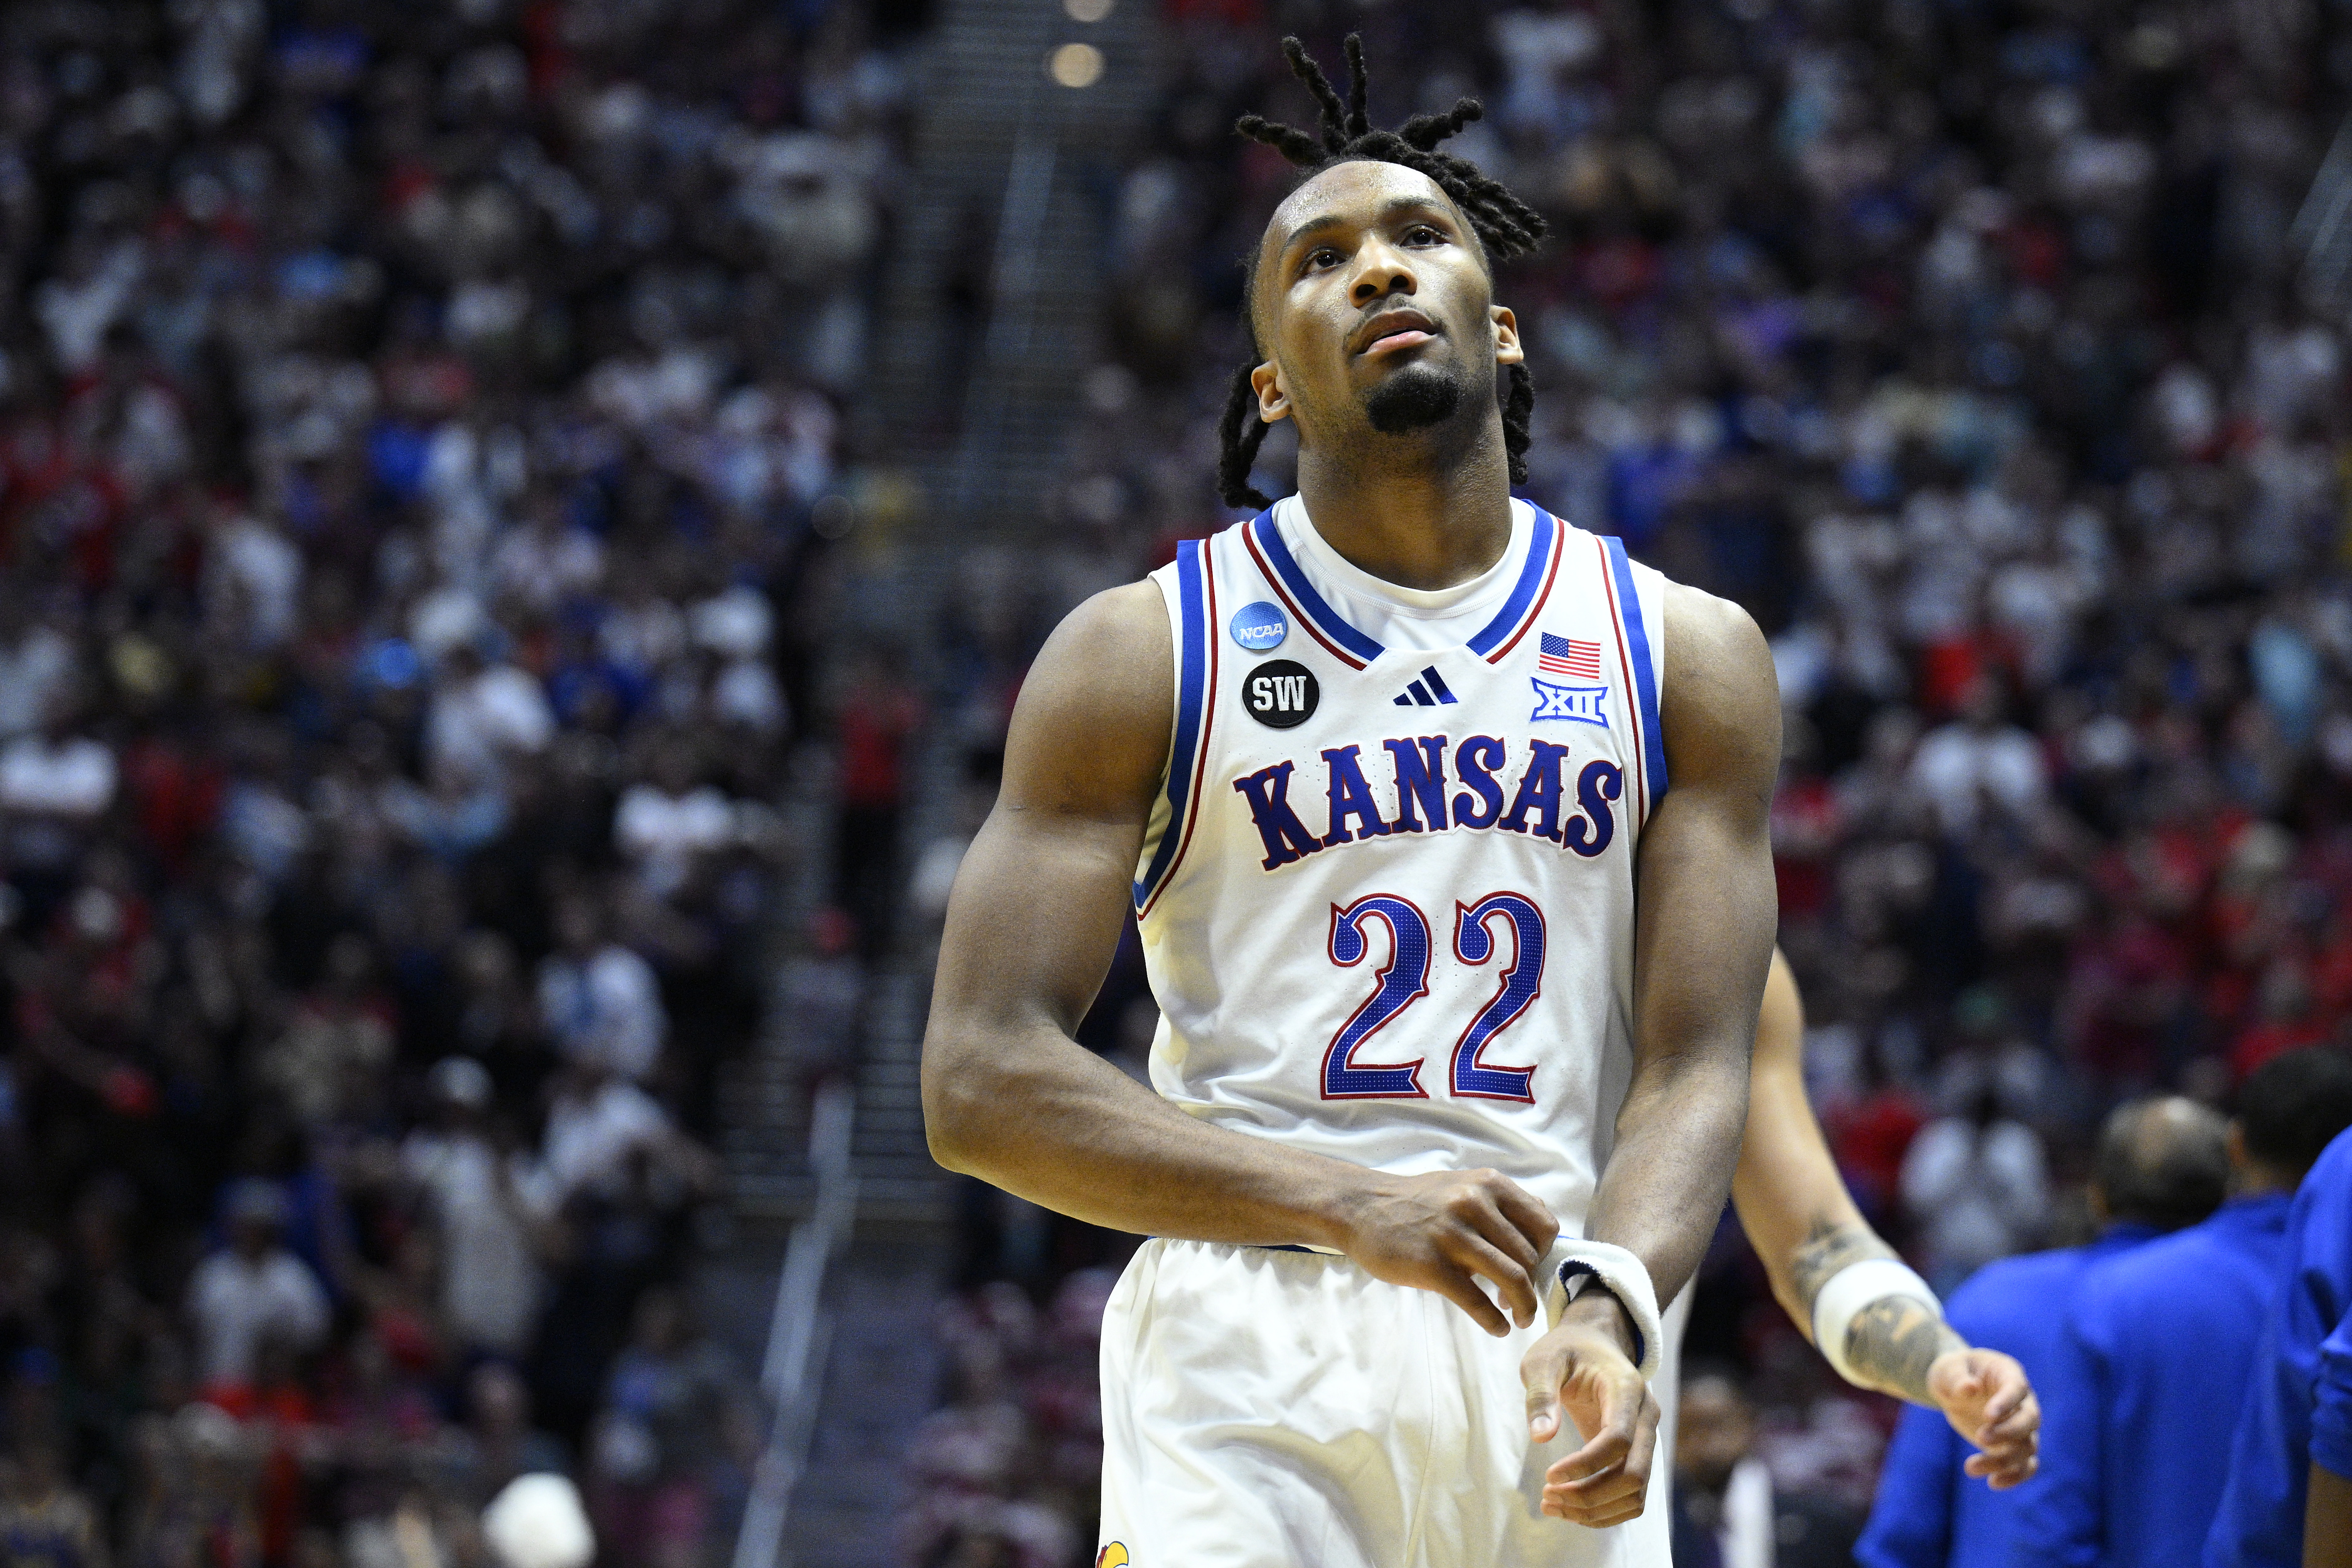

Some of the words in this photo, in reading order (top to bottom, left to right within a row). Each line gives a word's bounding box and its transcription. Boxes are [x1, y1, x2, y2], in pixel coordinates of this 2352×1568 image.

[1239, 623, 1284, 640] NCAA
[1252, 676, 1307, 711] SW
[1533, 679, 1607, 726] XII
[1233, 734, 1623, 871] KANSAS
[1320, 890, 1546, 1104] 22
